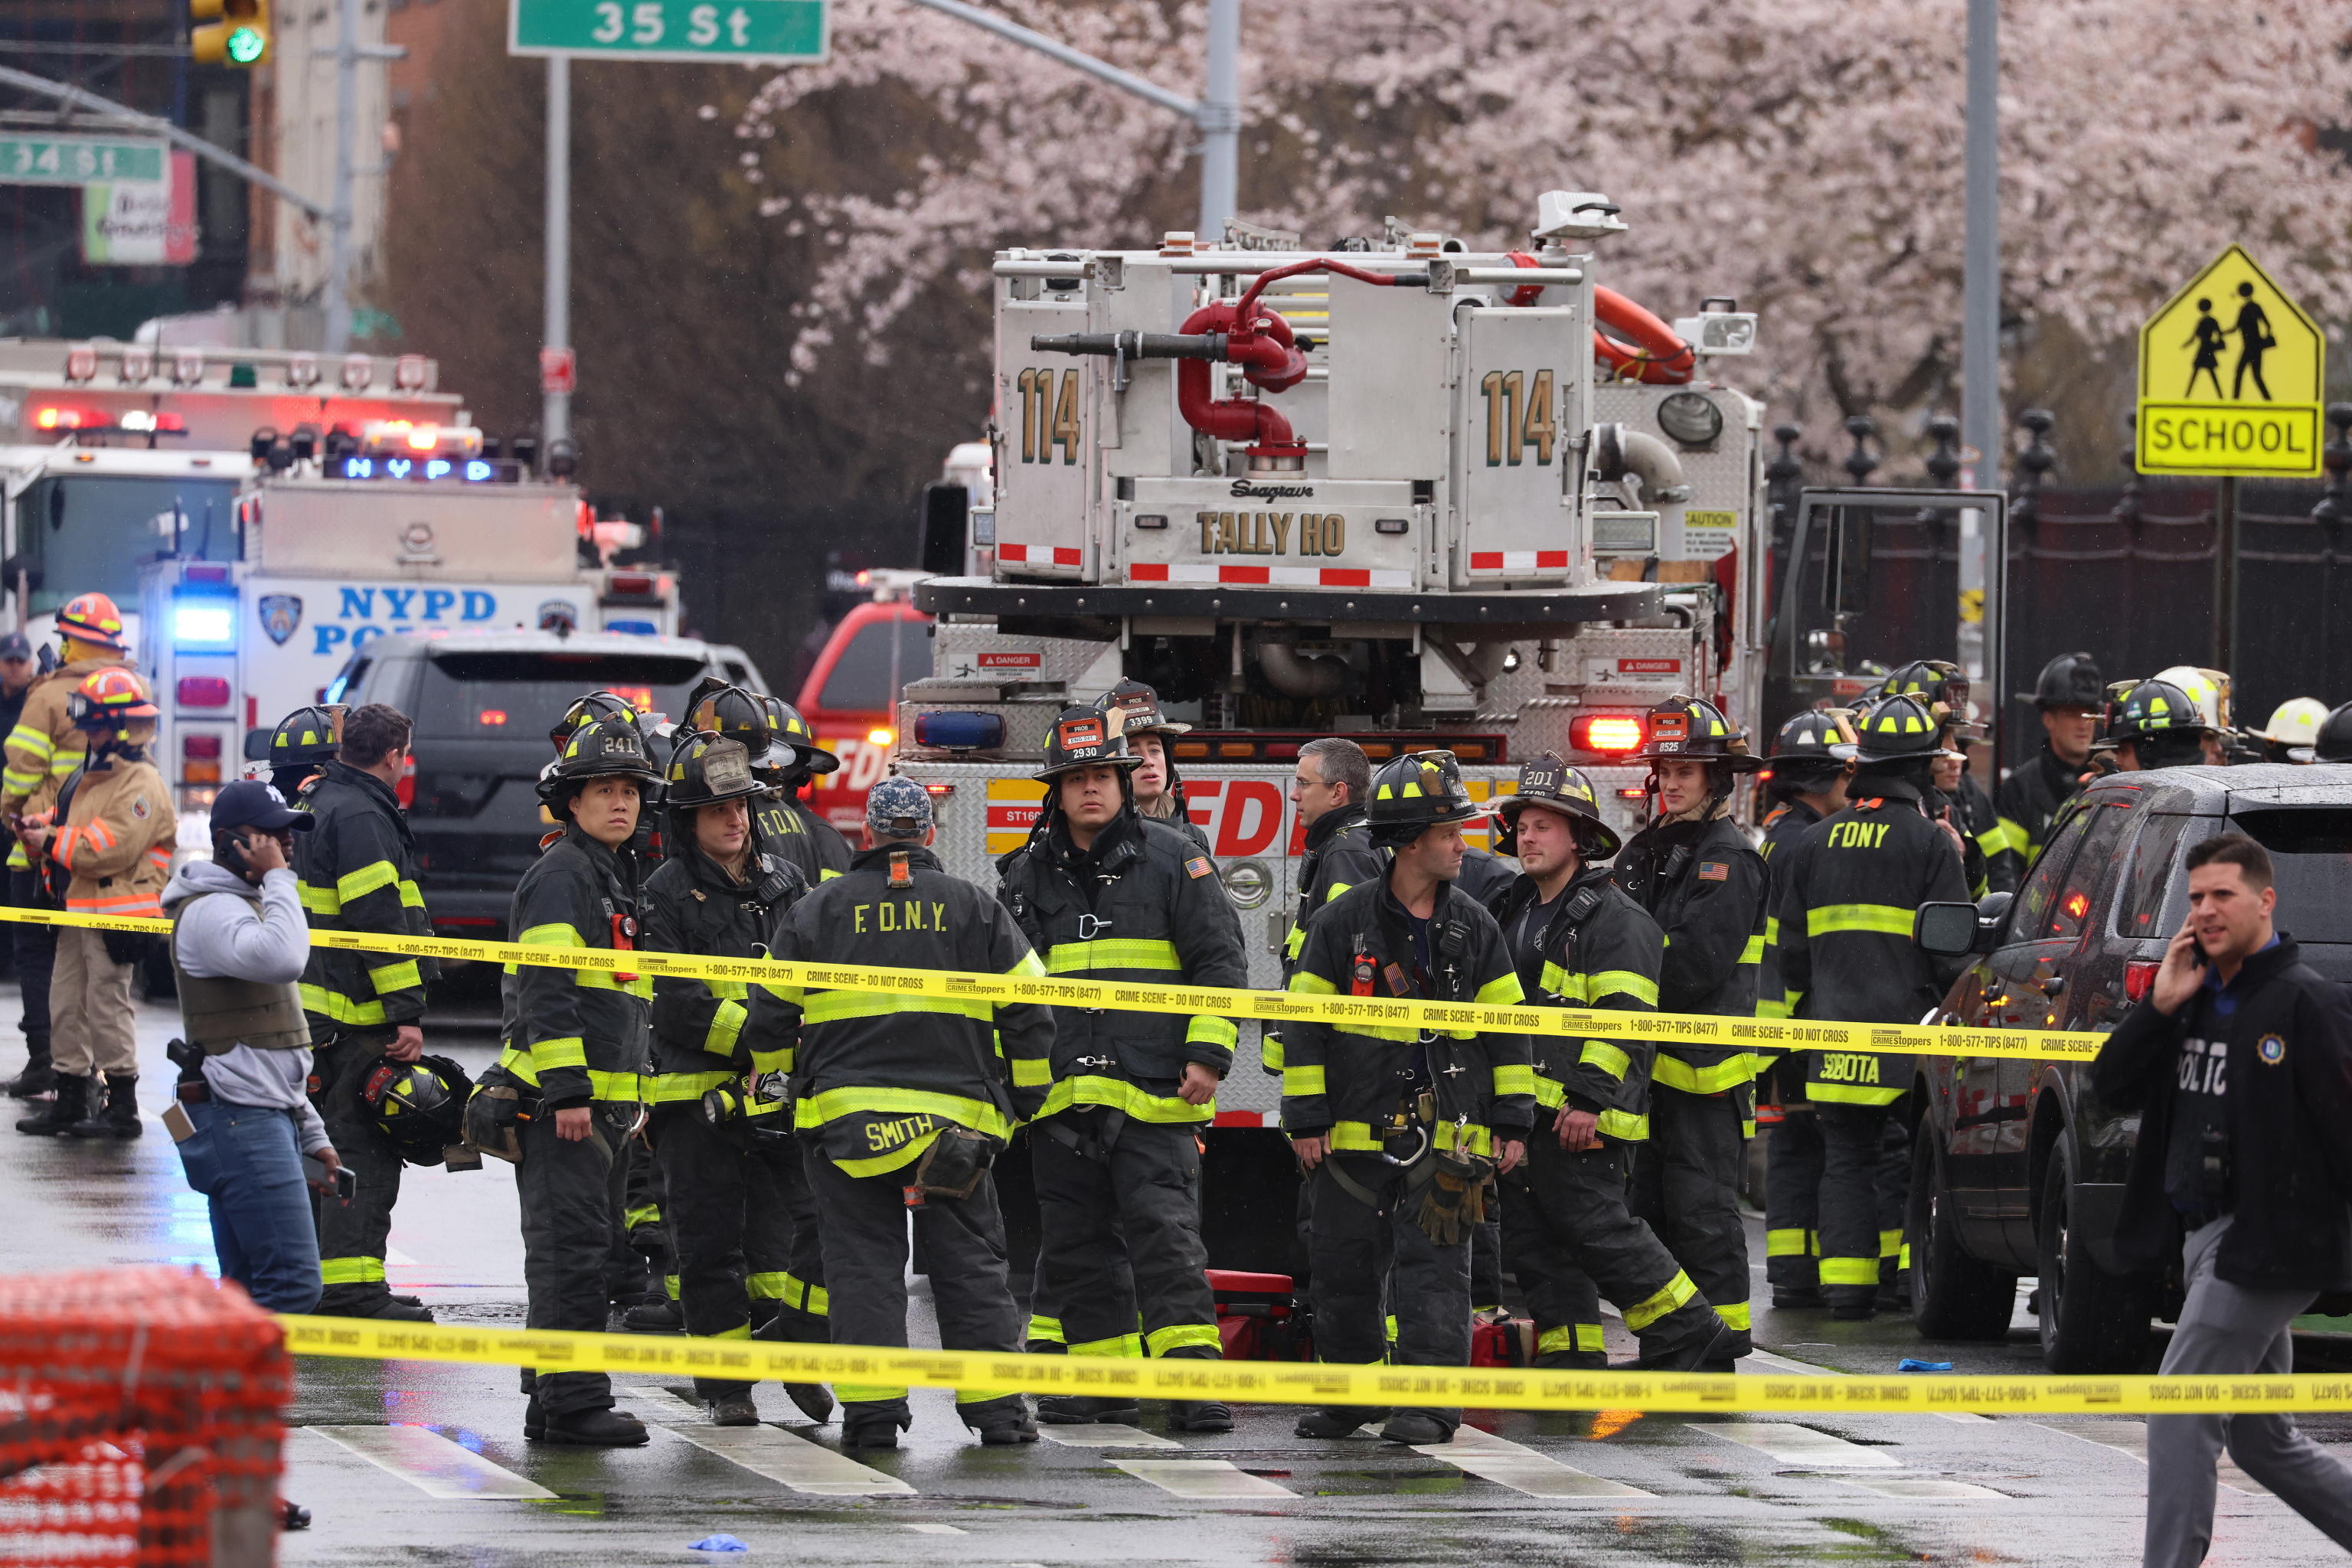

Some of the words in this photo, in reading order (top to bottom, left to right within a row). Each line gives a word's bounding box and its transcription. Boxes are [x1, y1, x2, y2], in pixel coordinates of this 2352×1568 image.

[592, 2, 667, 44] 35
[688, 5, 752, 47] St
[1018, 368, 1080, 466] 114
[1481, 369, 1556, 467] 114
[2152, 419, 2305, 453] SCHOOL
[346, 457, 492, 481] NYPD
[1230, 479, 1314, 504] Seagrave
[1196, 511, 1294, 555] TALLY
[1299, 512, 1345, 557] HO
[338, 586, 497, 621] NYPD
[1129, 716, 1153, 727] 3399
[605, 737, 635, 753] 241
[1073, 747, 1097, 759] 2930
[1659, 742, 1678, 752] 8525
[1524, 771, 1553, 786] 201
[1828, 822, 1890, 848] FDNY
[461, 946, 485, 958] (8477)
[498, 951, 524, 961] CRIME
[526, 952, 550, 962] SCENE
[560, 955, 570, 964] DO
[573, 956, 588, 965] NOT
[590, 957, 615, 968] CROSS
[706, 965, 767, 978] 1-800-577-TIPS
[769, 966, 793, 980] (8477)
[807, 971, 832, 982] CRIME
[834, 972, 859, 984] SCENE
[868, 975, 879, 985] DO
[881, 975, 897, 986] NOT
[898, 977, 924, 989] CROSS
[1014, 984, 1076, 998] 1-800-577-TIPS
[1077, 986, 1102, 1000] (8477)
[1116, 990, 1140, 1002] CRIME
[1142, 991, 1168, 1004] SCENE
[1176, 994, 1187, 1005] DO
[1189, 995, 1205, 1006] NOT
[1207, 996, 1232, 1008] CROSS
[1322, 1002, 1383, 1017] 1-800-577-TIPS
[1385, 1004, 1410, 1020] (8477)
[1423, 1008, 1449, 1021] CRIME
[1450, 1010, 1475, 1023] SCENE
[1484, 1012, 1495, 1024] DO
[1497, 1013, 1513, 1025] NOT
[1514, 1014, 1540, 1027] CROSS
[1630, 1019, 1692, 1034] 1-800-577-TIPS
[1694, 1021, 1718, 1036] (8477)
[1732, 1024, 1757, 1037] CRIME
[1759, 1026, 1784, 1039] SCENE
[1793, 1027, 1804, 1040] DO
[1805, 1028, 1822, 1041] NOT
[1823, 1029, 1849, 1043] CROSS
[1940, 1034, 2001, 1048] 1-800-577-TIPS
[2003, 1036, 2027, 1050] (8477)
[2041, 1038, 2066, 1051] CRIME
[2068, 1040, 2093, 1053] SCENE
[865, 1114, 934, 1152] SMITH
[2148, 1384, 2181, 1402] CROSS
[2182, 1384, 2203, 1401] NOT
[2205, 1384, 2219, 1401] DO
[2230, 1383, 2262, 1401] SCENE
[2263, 1383, 2295, 1401] CRIME
